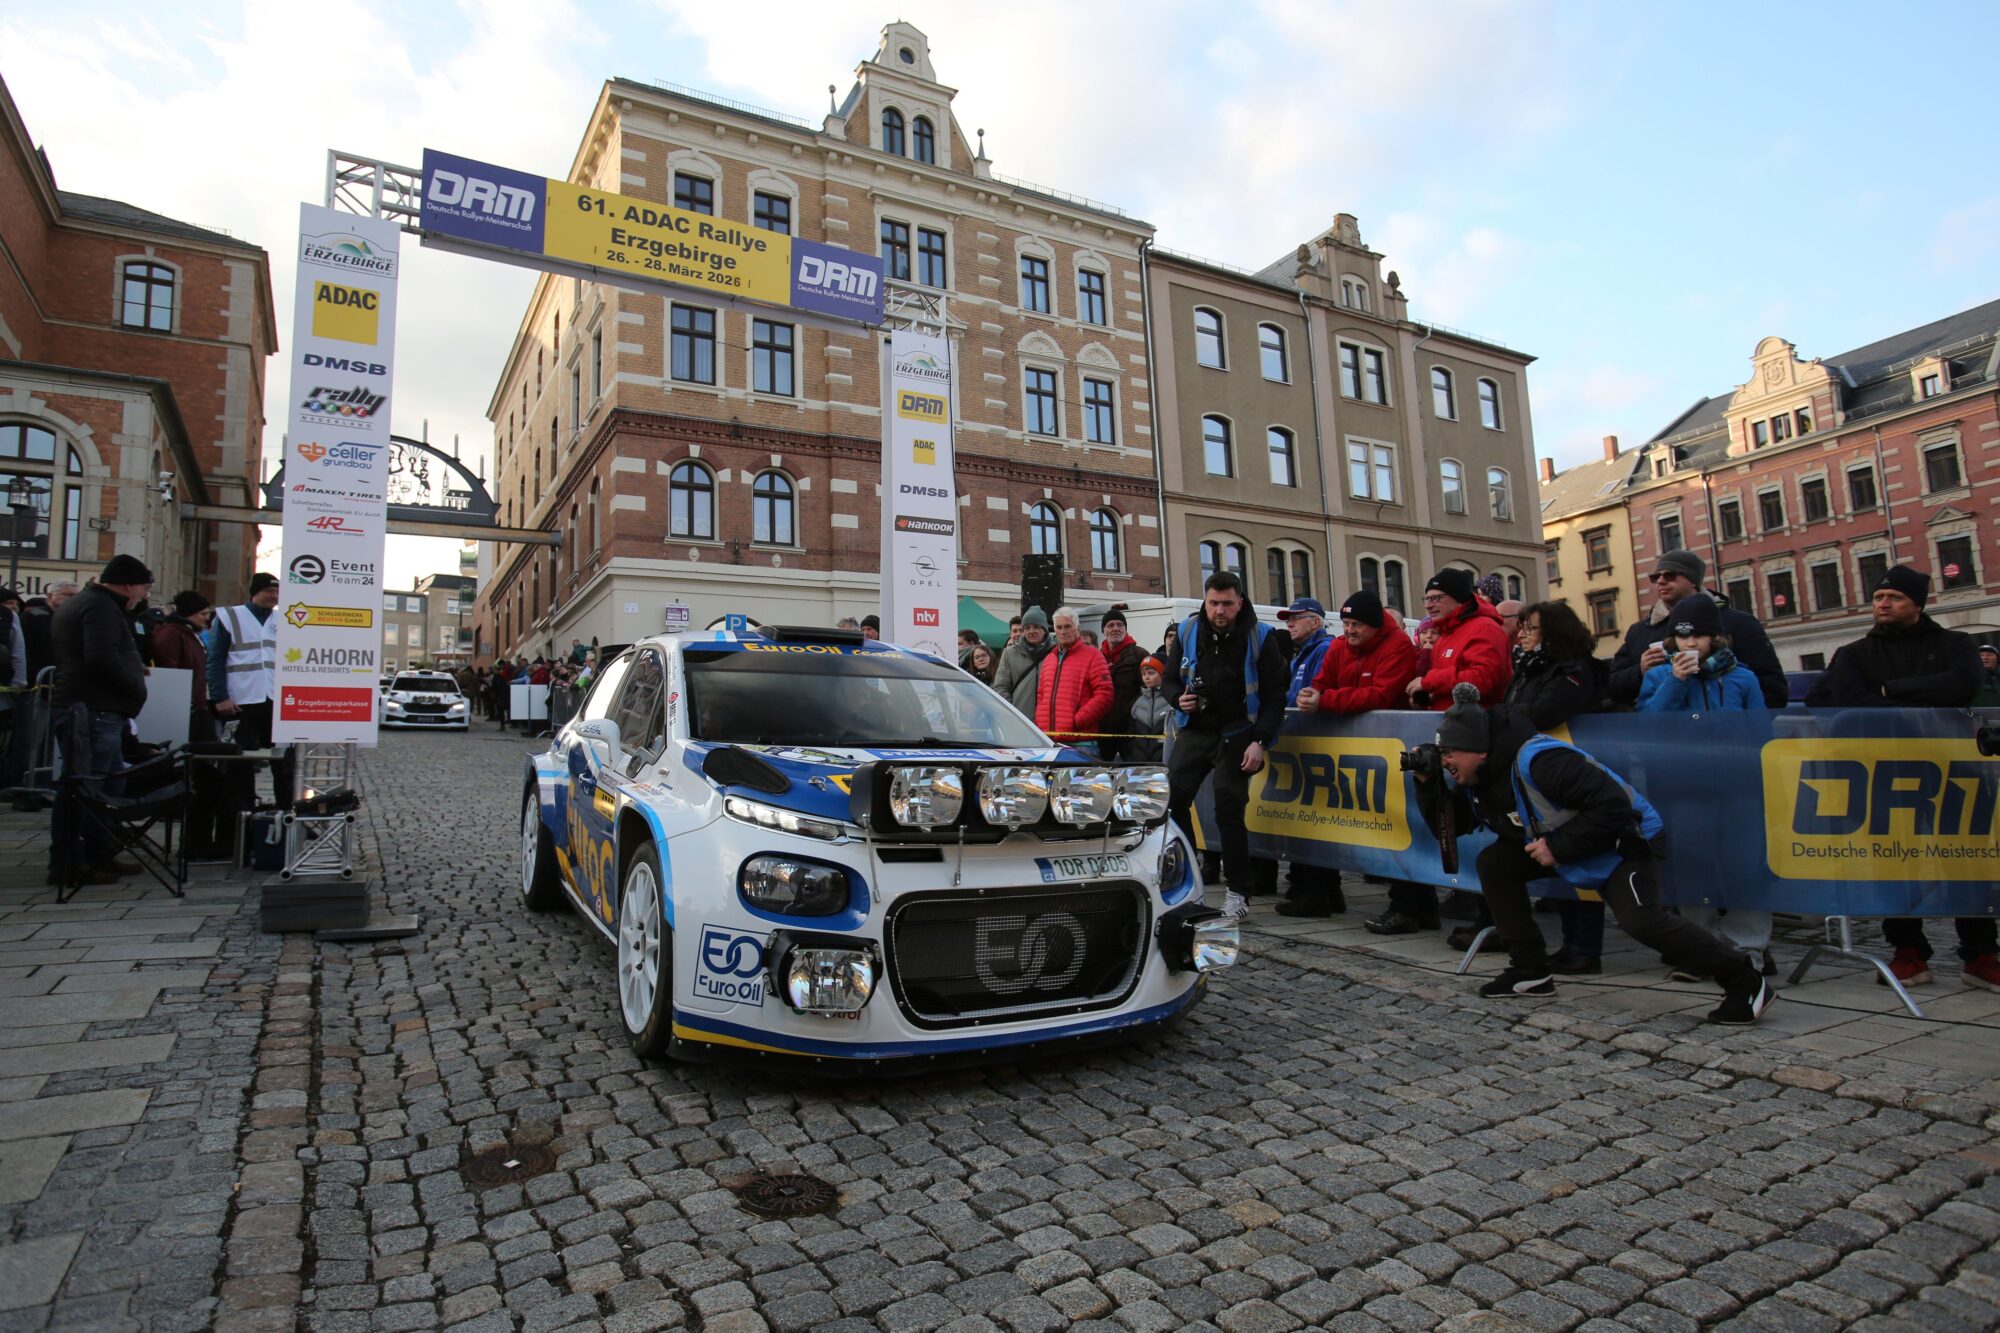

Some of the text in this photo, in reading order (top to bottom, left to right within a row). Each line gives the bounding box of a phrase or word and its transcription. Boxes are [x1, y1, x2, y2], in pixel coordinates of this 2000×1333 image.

[427, 168, 536, 222] DRM
[426, 202, 532, 232] Deutsche Rallye-Meisterschaft
[577, 194, 768, 253] 61. ADAC Rallye
[611, 227, 737, 271] Erzgebirge
[304, 247, 395, 272] ERZGEBIRGE
[606, 250, 630, 264] 26.
[644, 257, 666, 272] 28.
[668, 262, 703, 280] März
[707, 271, 741, 288] 2026
[798, 255, 878, 298] DRM
[317, 284, 377, 311] ADAC
[797, 283, 876, 306] Deutsche Rallye-Meisterschaft
[303, 353, 387, 376] DMSB
[896, 364, 951, 380] ERZGEBIRGE
[308, 385, 387, 417] rally
[901, 394, 944, 415] DRM
[328, 447, 377, 462] celler
[913, 439, 935, 451] ADAC
[323, 458, 372, 470] grundbau
[305, 487, 346, 497] MAXEN
[348, 492, 382, 500] TIRES
[899, 484, 948, 498] DMSB
[307, 515, 364, 533] 4R
[330, 559, 375, 573] Event
[910, 579, 941, 588] OPEL
[730, 616, 742, 631] P
[916, 611, 936, 623] ntv
[305, 647, 374, 667] AHORN
[742, 642, 843, 655] EuroOil
[282, 665, 311, 673] HOTELS
[318, 666, 351, 674] RESORTS
[298, 699, 369, 708] Erzgebirgssparkasse
[1260, 752, 1388, 814] DRM
[1792, 760, 2000, 836] DRM
[1256, 806, 1393, 832] Deutsche Rallye-Meisterschaft
[1792, 841, 1867, 858] Deutsche
[1044, 873, 1054, 881] CZ
[1053, 858, 1087, 877] 10R
